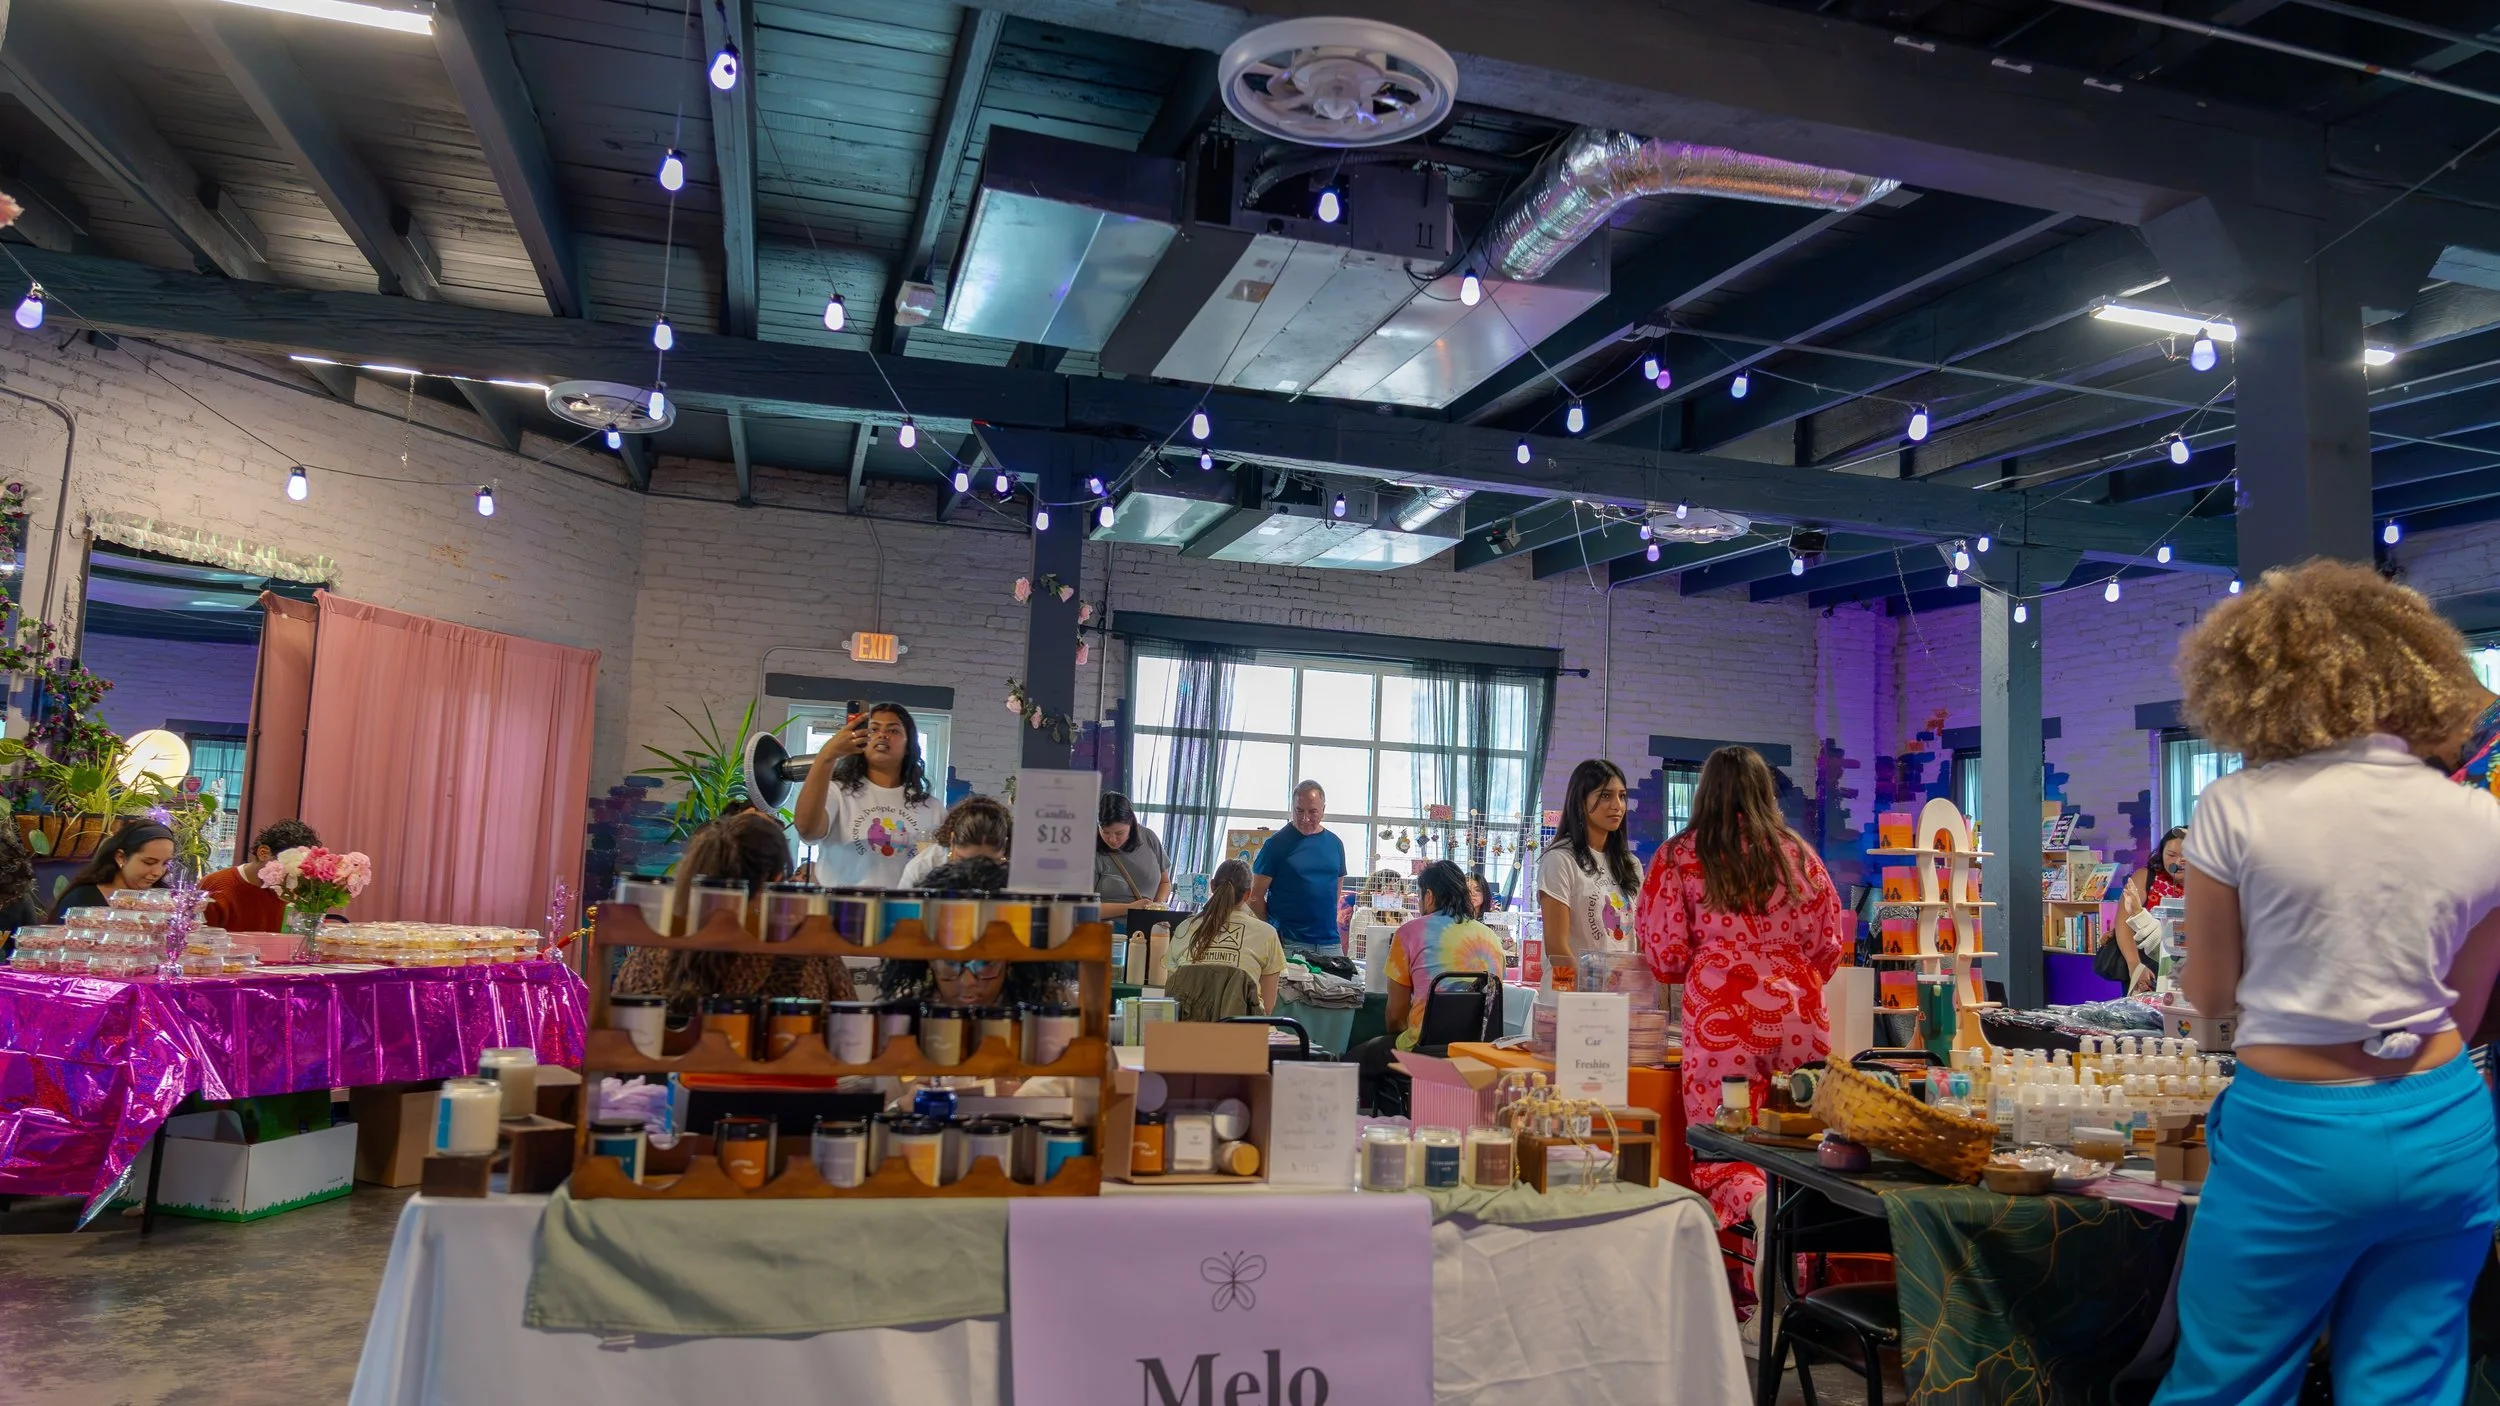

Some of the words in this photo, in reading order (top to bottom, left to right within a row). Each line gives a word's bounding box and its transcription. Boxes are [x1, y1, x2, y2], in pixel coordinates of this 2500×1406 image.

[858, 632, 893, 660] EXIT
[1035, 808, 1076, 820] Candles
[1037, 824, 1072, 844] $18
[1584, 1036, 1602, 1047] Car
[1575, 1058, 1611, 1070] Freshies
[1136, 1349, 1330, 1406] Melo
